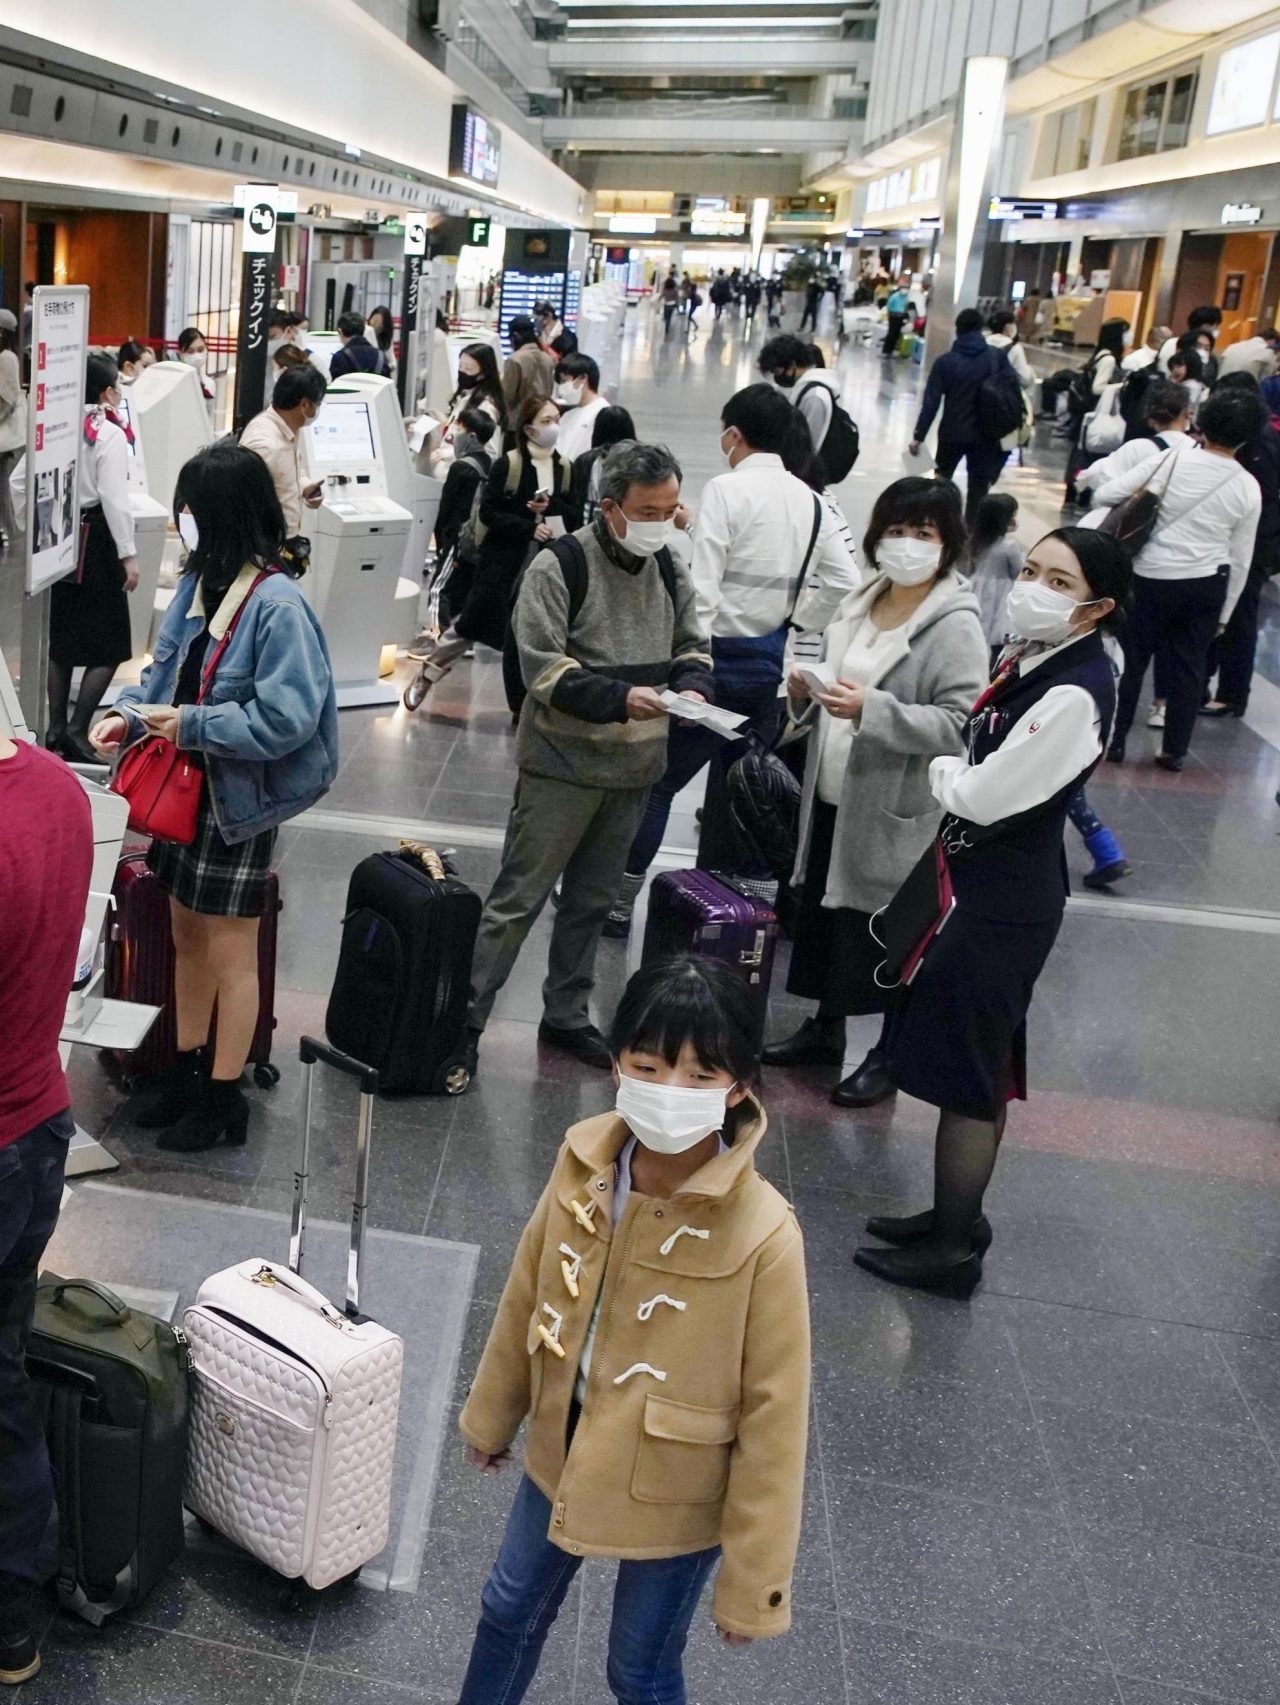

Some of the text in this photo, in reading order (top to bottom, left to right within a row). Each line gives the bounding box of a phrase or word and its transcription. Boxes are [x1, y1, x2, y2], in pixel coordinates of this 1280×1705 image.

[473, 223, 486, 242] F
[248, 258, 267, 349] チェックイン
